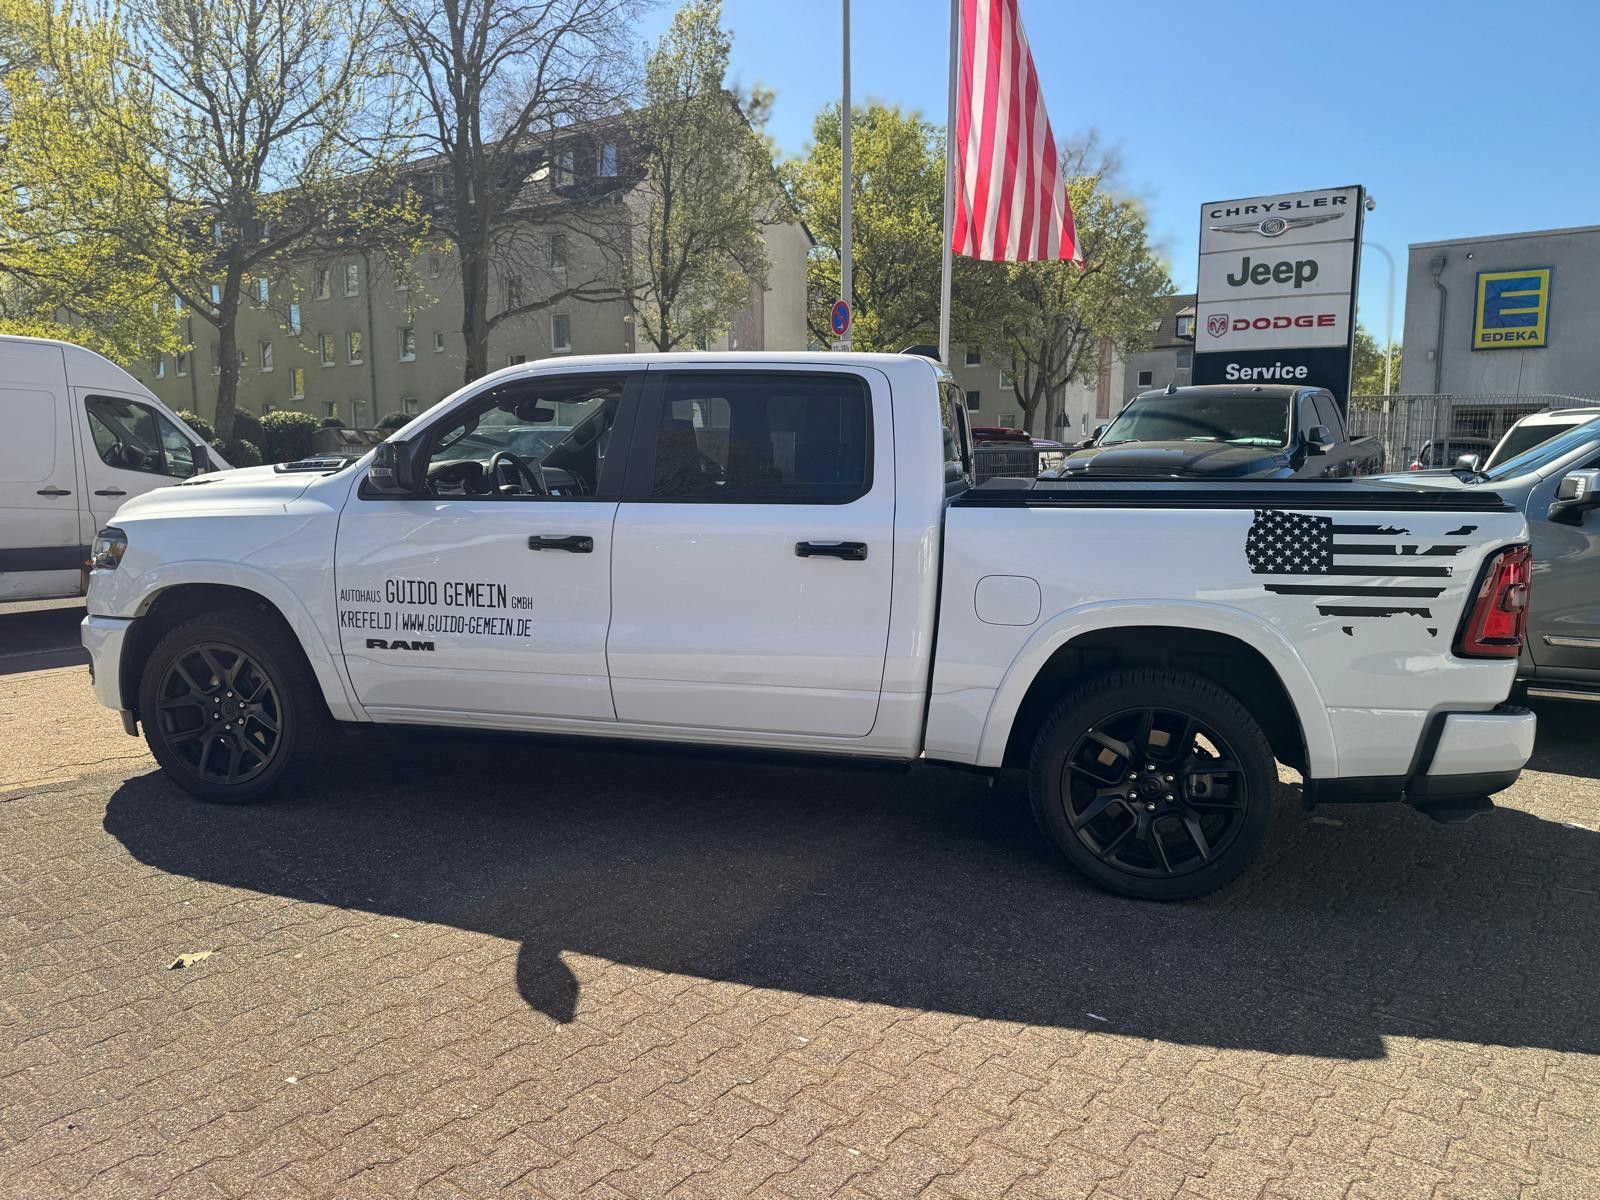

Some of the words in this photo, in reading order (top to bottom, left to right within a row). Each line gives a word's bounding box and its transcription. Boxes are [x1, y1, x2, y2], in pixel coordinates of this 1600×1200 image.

[1210, 195, 1347, 219] CHRYSLER
[1226, 256, 1319, 289] Jeep
[1232, 314, 1336, 332] DODGE
[1481, 330, 1539, 343] EDEKA
[1225, 362, 1308, 380] Service
[340, 589, 381, 603] AUTOHAUS
[385, 579, 437, 605] GUIDO
[444, 582, 507, 609] GEMEIN
[511, 596, 533, 610] GMBH
[340, 610, 392, 630] KREFELD
[402, 613, 532, 637] WWW.GUIDO-GEMEIN.DE
[366, 638, 435, 652] RAM
